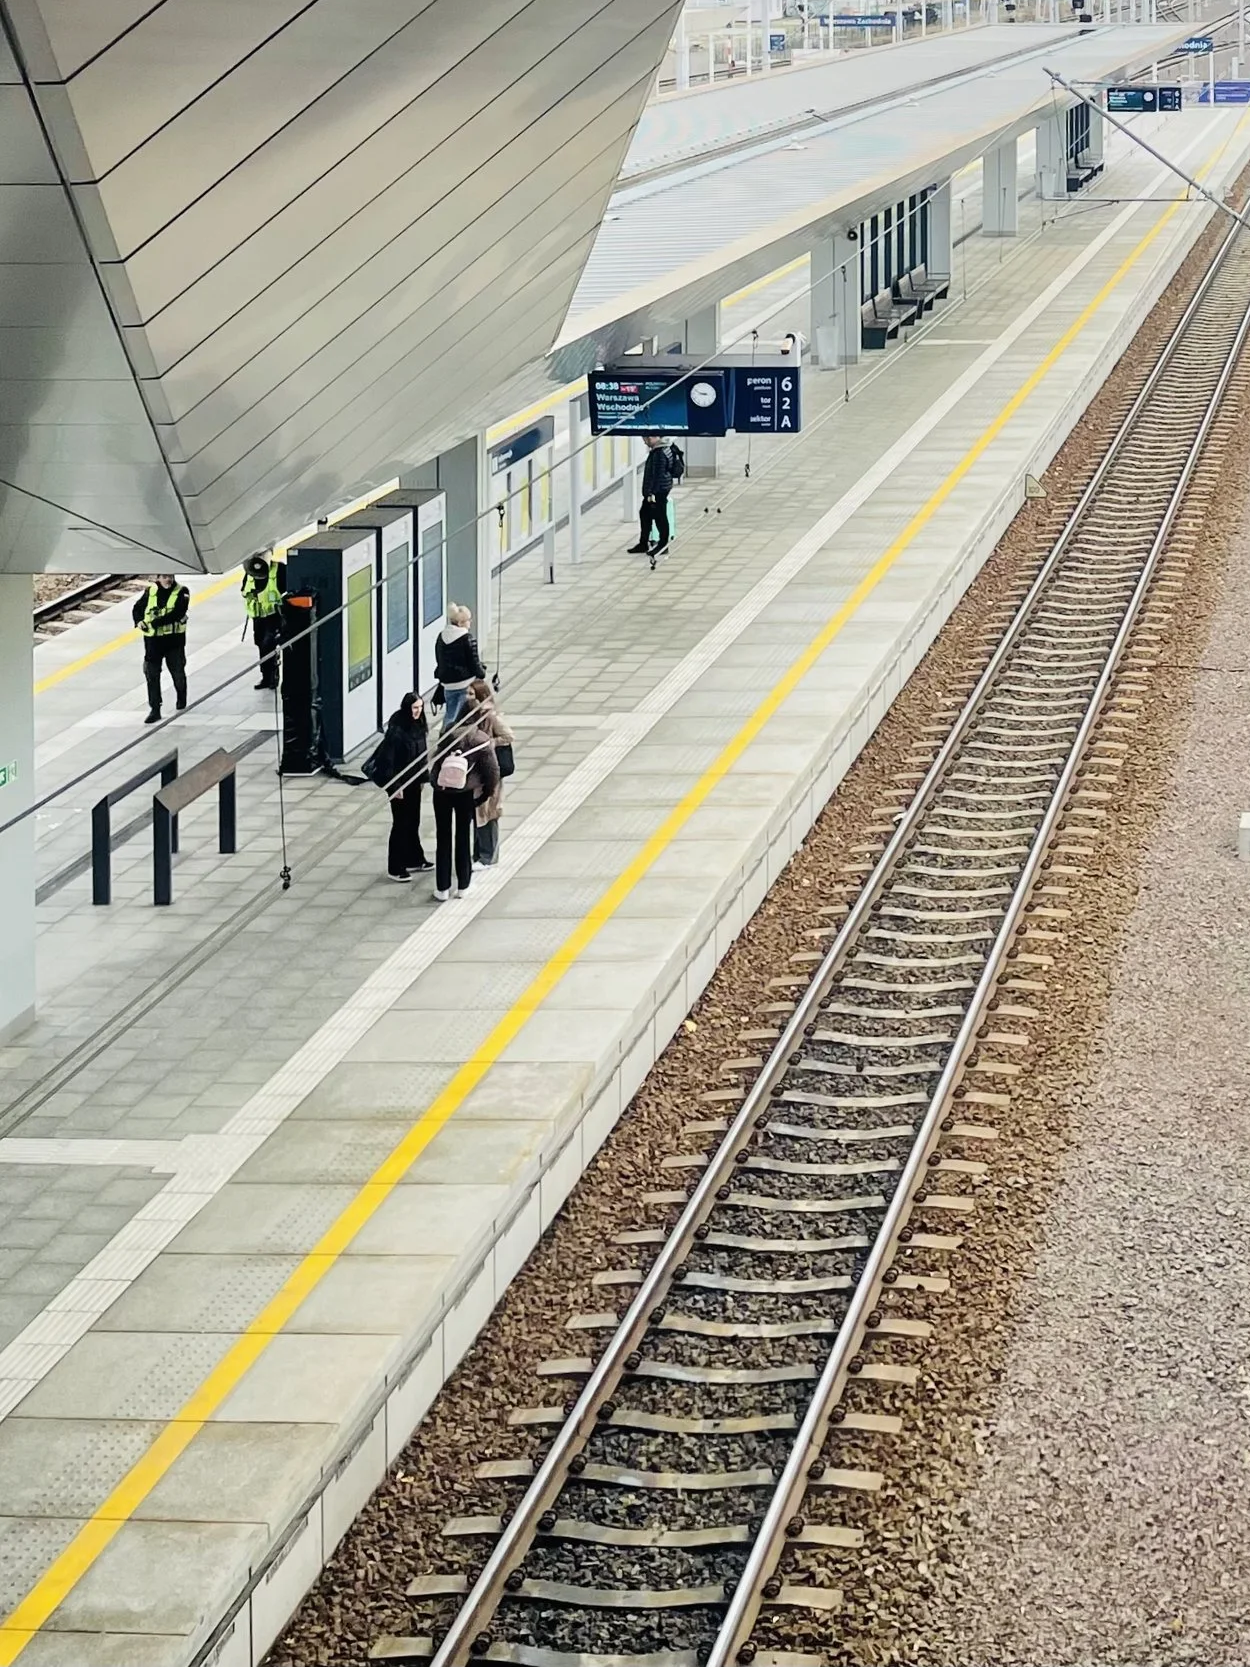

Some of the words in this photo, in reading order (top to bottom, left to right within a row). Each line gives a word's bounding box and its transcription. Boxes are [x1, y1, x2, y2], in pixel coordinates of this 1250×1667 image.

[747, 378, 772, 386] peron
[782, 376, 792, 392] 6
[596, 394, 640, 402] Warszawa
[782, 397, 791, 409] 2
[781, 415, 791, 428] A
